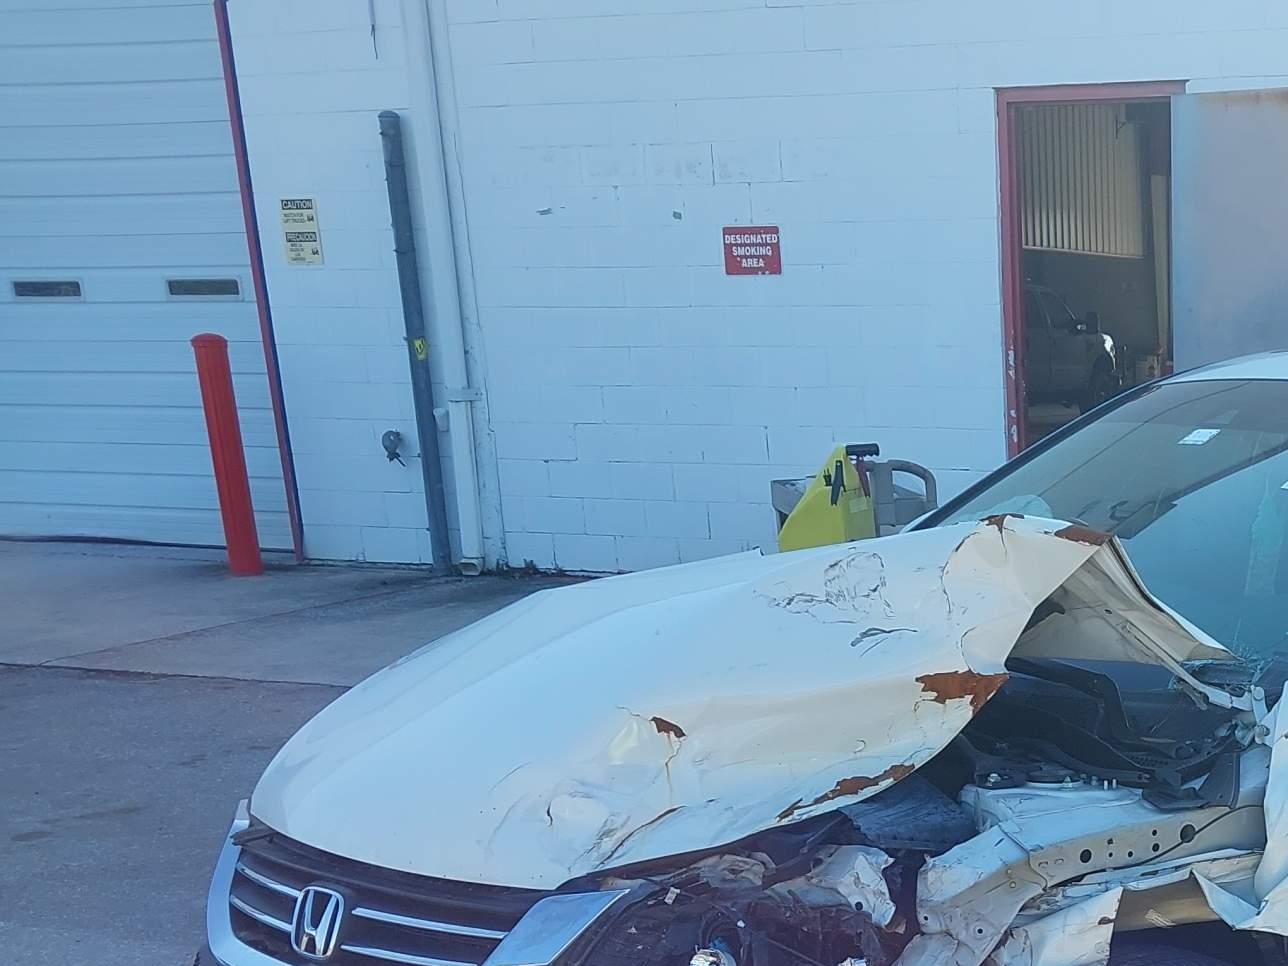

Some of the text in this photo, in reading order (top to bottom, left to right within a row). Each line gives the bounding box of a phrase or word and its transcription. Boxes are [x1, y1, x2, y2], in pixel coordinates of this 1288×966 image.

[283, 200, 312, 209] CAUTION
[725, 234, 777, 243] DESIGNATED
[732, 246, 772, 256] SMOKING
[742, 258, 765, 267] AREA
